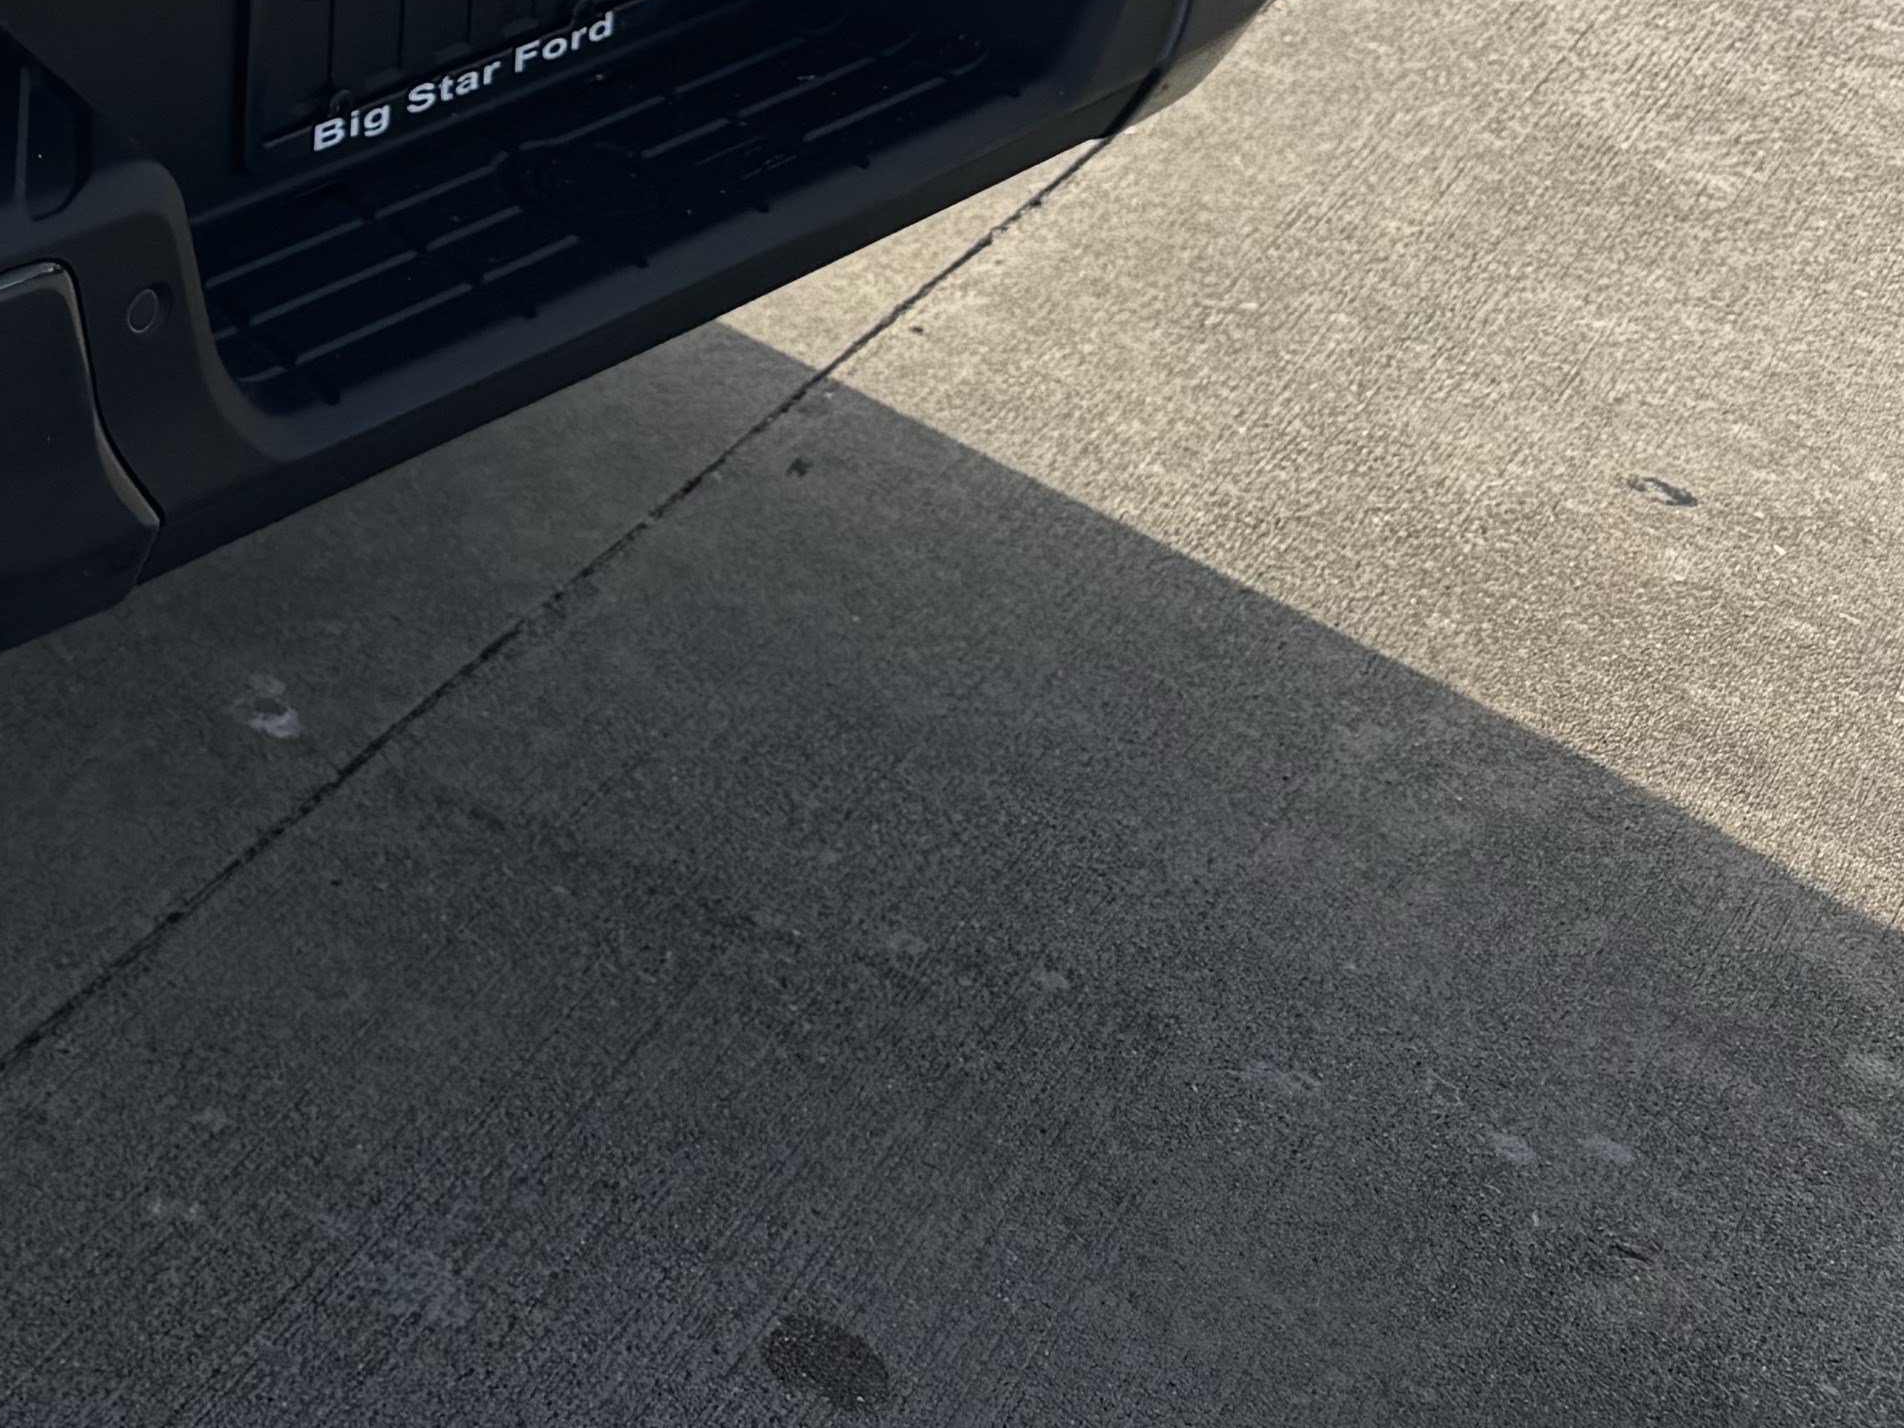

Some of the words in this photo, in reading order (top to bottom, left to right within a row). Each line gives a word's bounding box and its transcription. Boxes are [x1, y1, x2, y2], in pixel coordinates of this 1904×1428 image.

[312, 100, 391, 152] Big
[406, 56, 501, 114] Star
[514, 11, 615, 73] Ford
